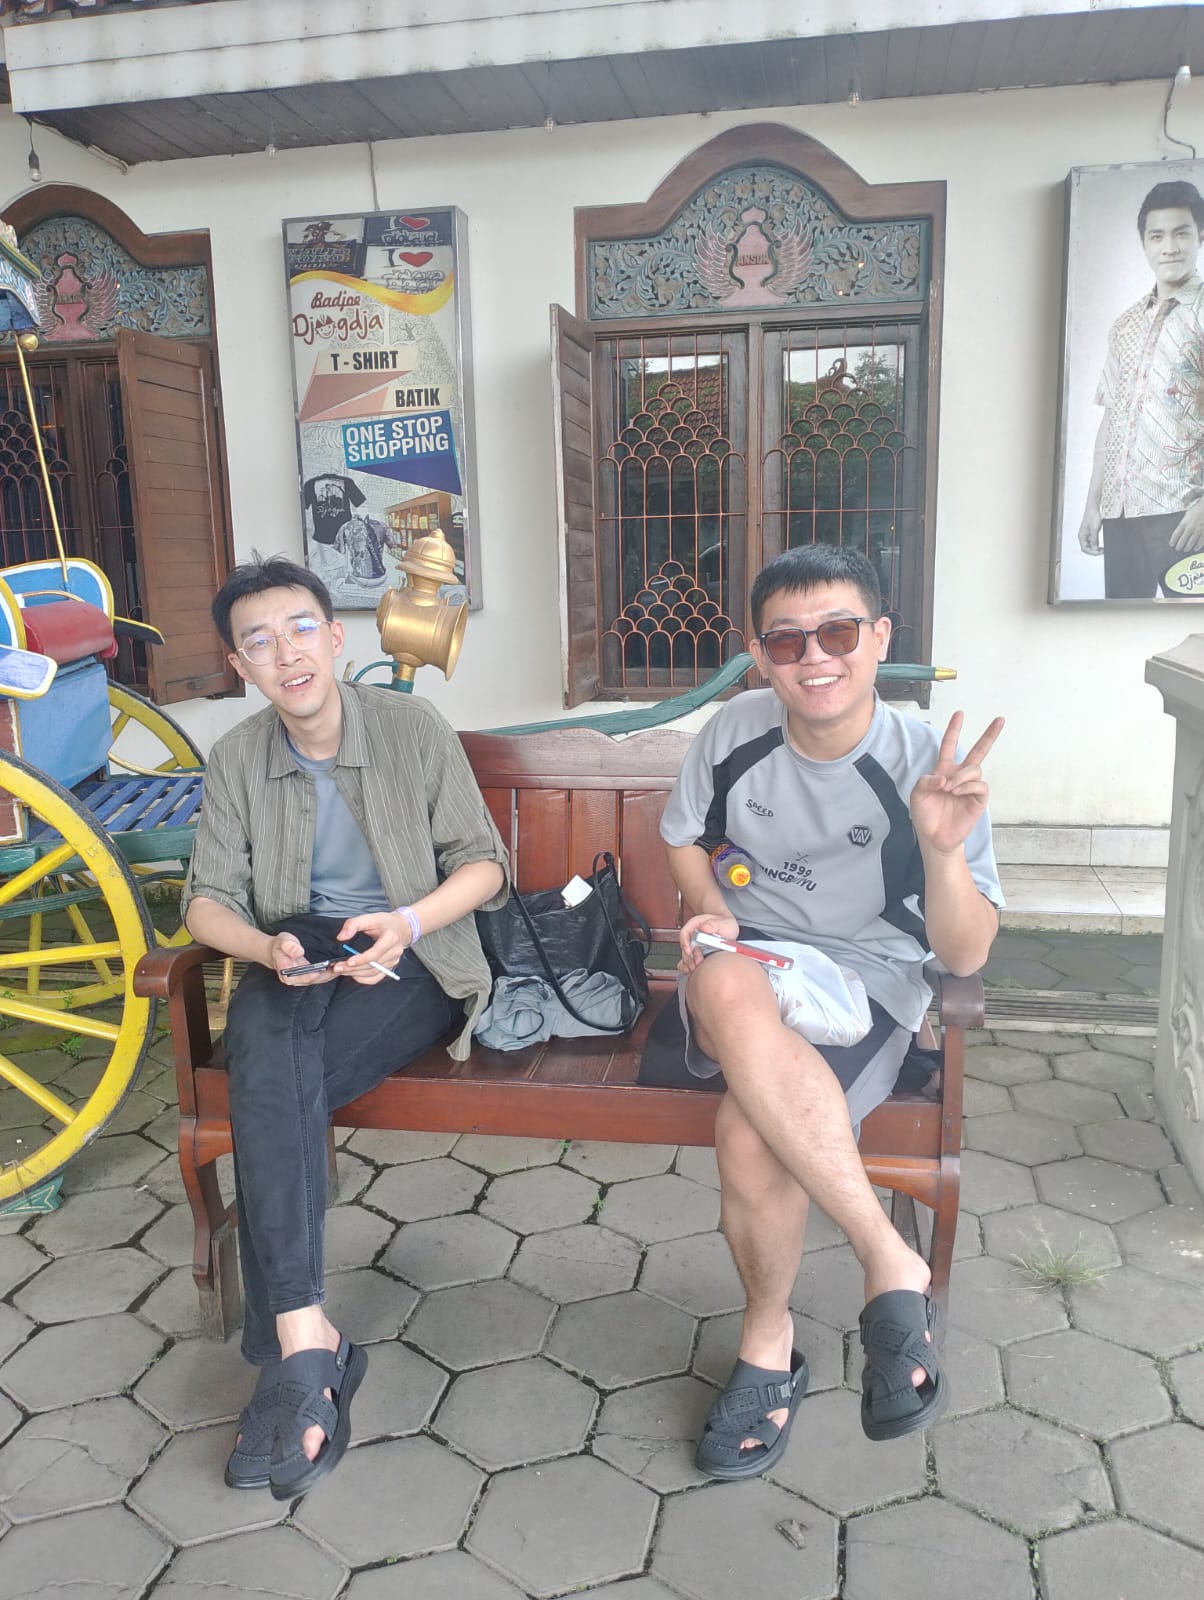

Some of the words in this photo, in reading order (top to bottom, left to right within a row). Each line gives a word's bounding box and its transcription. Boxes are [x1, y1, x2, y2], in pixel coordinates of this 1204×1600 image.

[311, 291, 361, 311] Badjoe
[395, 387, 441, 408] BATIK
[345, 424, 386, 445] ONE
[391, 416, 443, 439] STOP
[348, 433, 449, 462] SHOPPING
[783, 861, 813, 878] 1999
